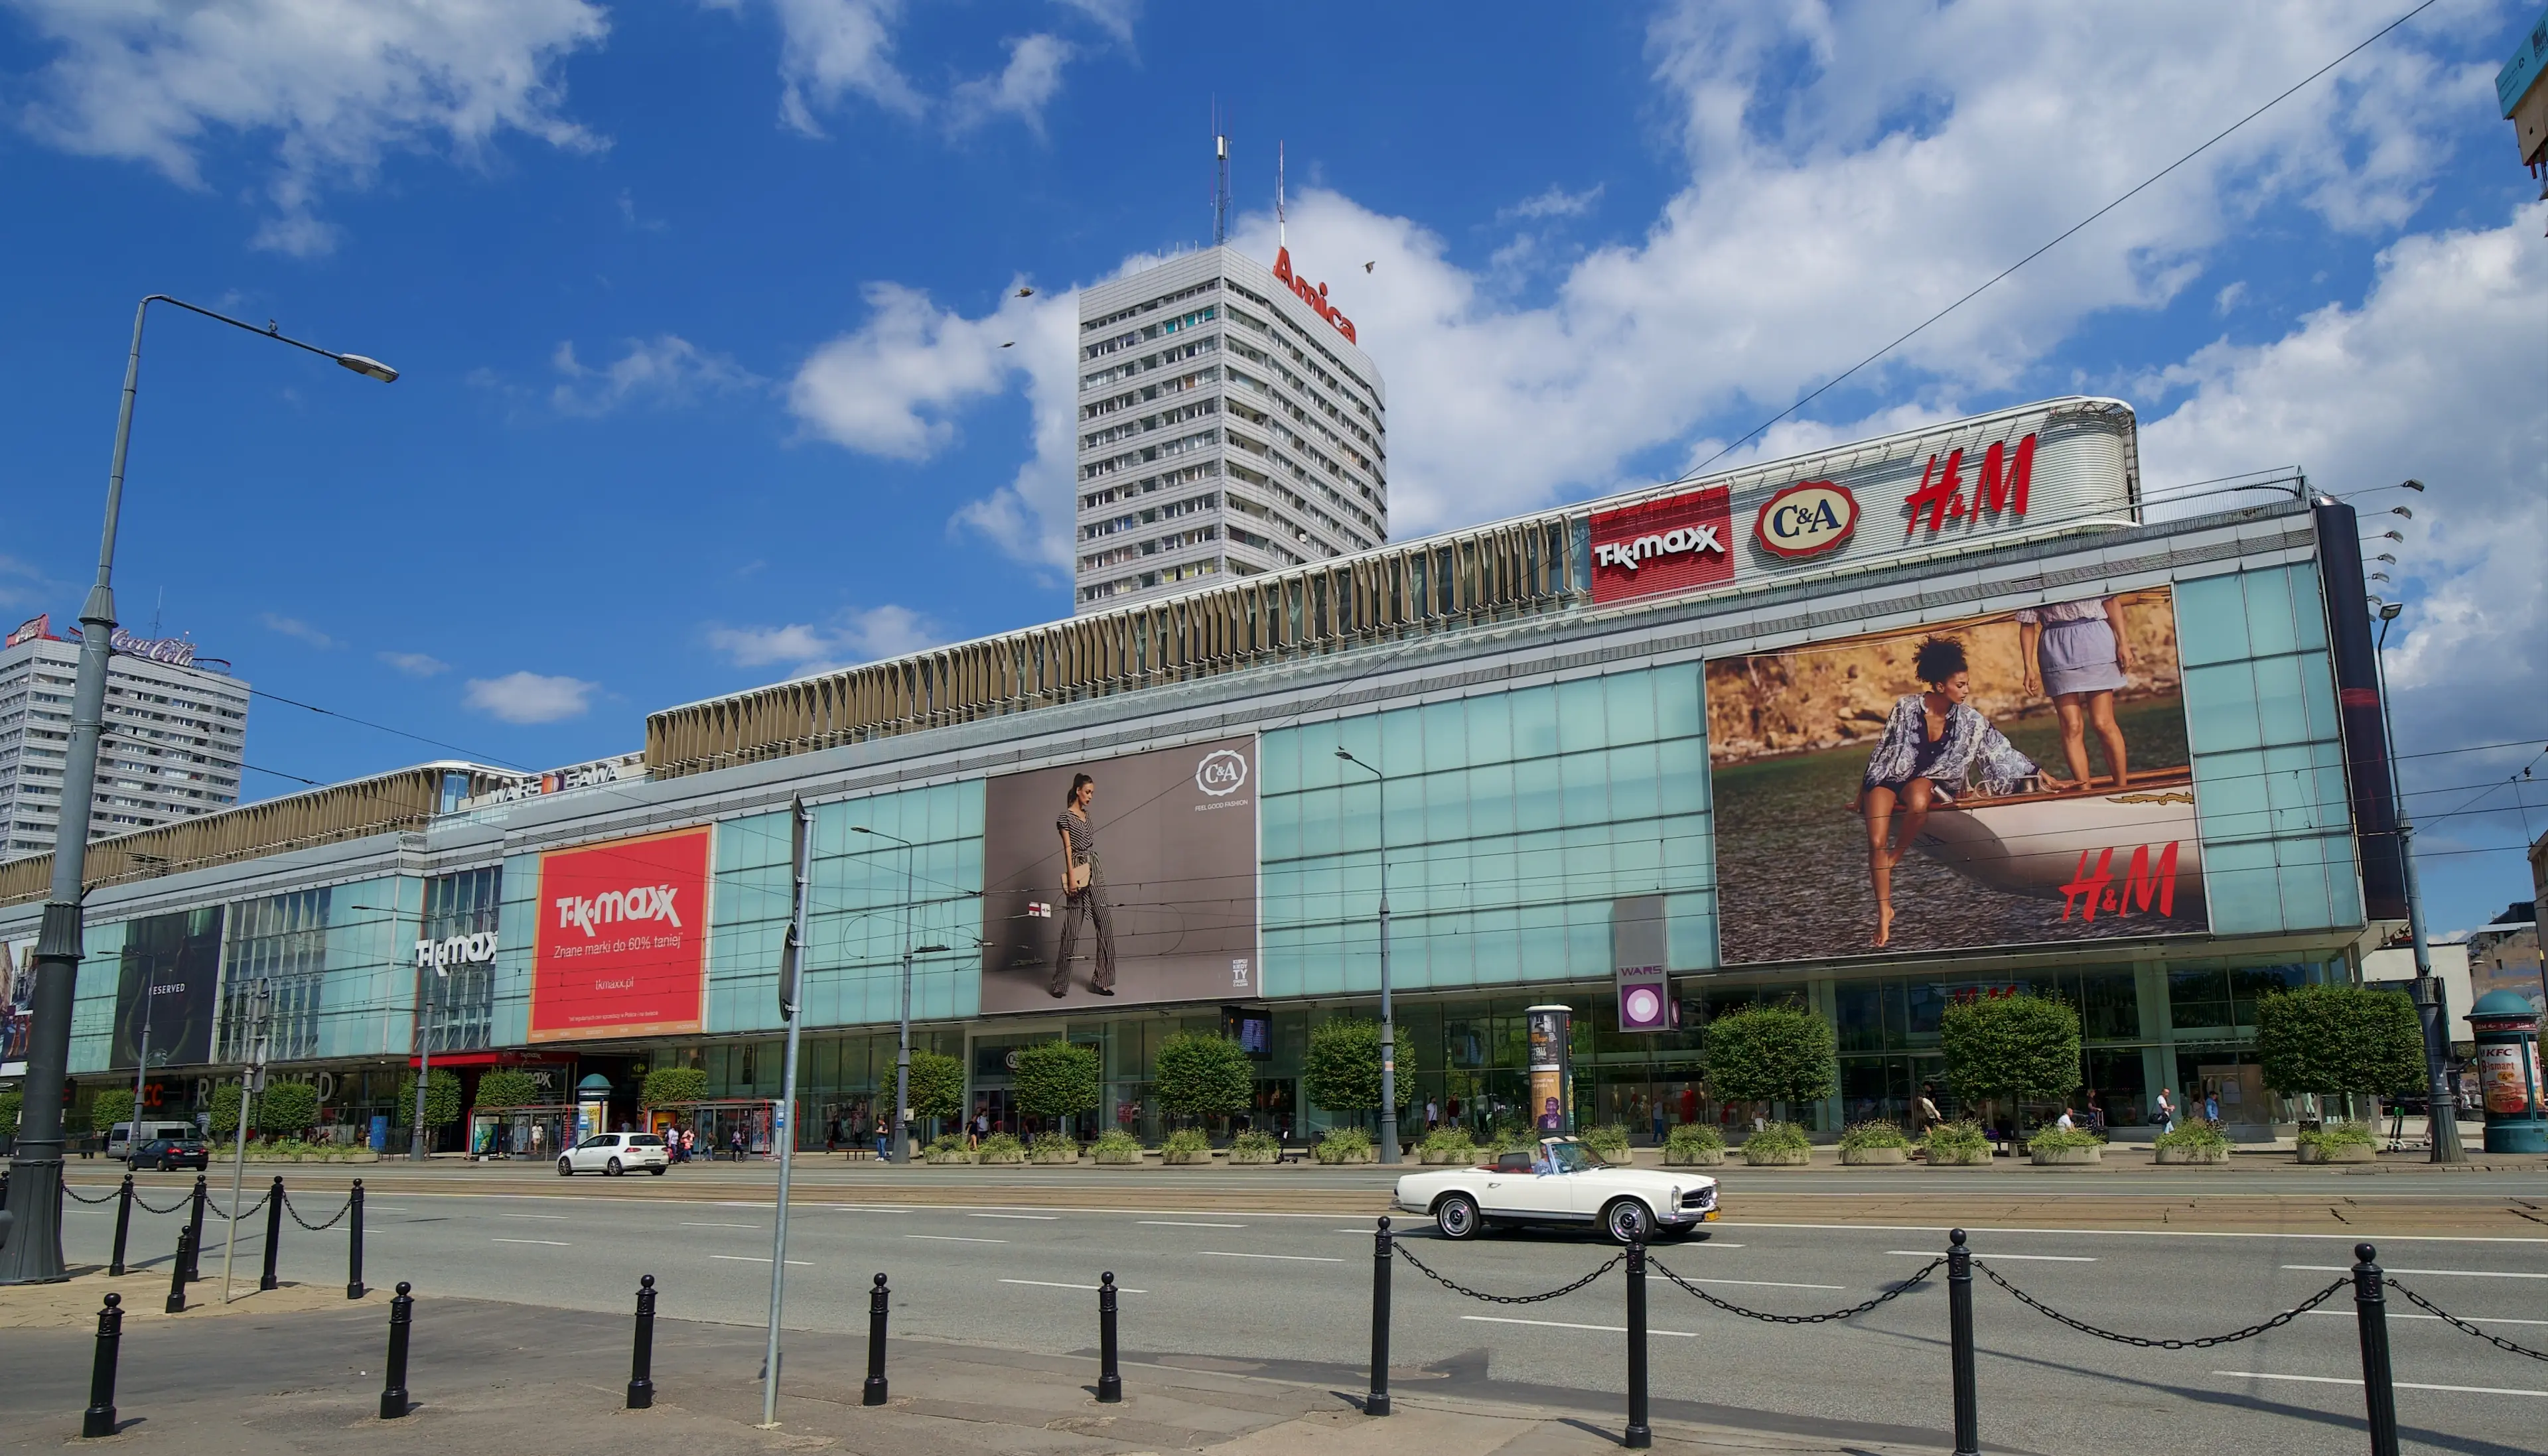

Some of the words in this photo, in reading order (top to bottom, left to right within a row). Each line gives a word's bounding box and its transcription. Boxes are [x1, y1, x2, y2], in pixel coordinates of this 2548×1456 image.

[1273, 246, 1356, 346] Amica
[1905, 432, 2036, 535] H&M
[1773, 499, 1841, 538] C&A
[490, 779, 542, 804] WARS
[566, 765, 621, 789] SAWA
[1205, 761, 1238, 783] C&A
[2058, 840, 2178, 923] H&M
[553, 946, 582, 958] Znane
[585, 941, 611, 955] marki
[613, 939, 626, 953] do
[628, 936, 651, 951] 60%
[595, 976, 634, 990] tkmaxx.pl
[1621, 966, 1662, 976] WARS
[2486, 1048, 2513, 1057] KFC
